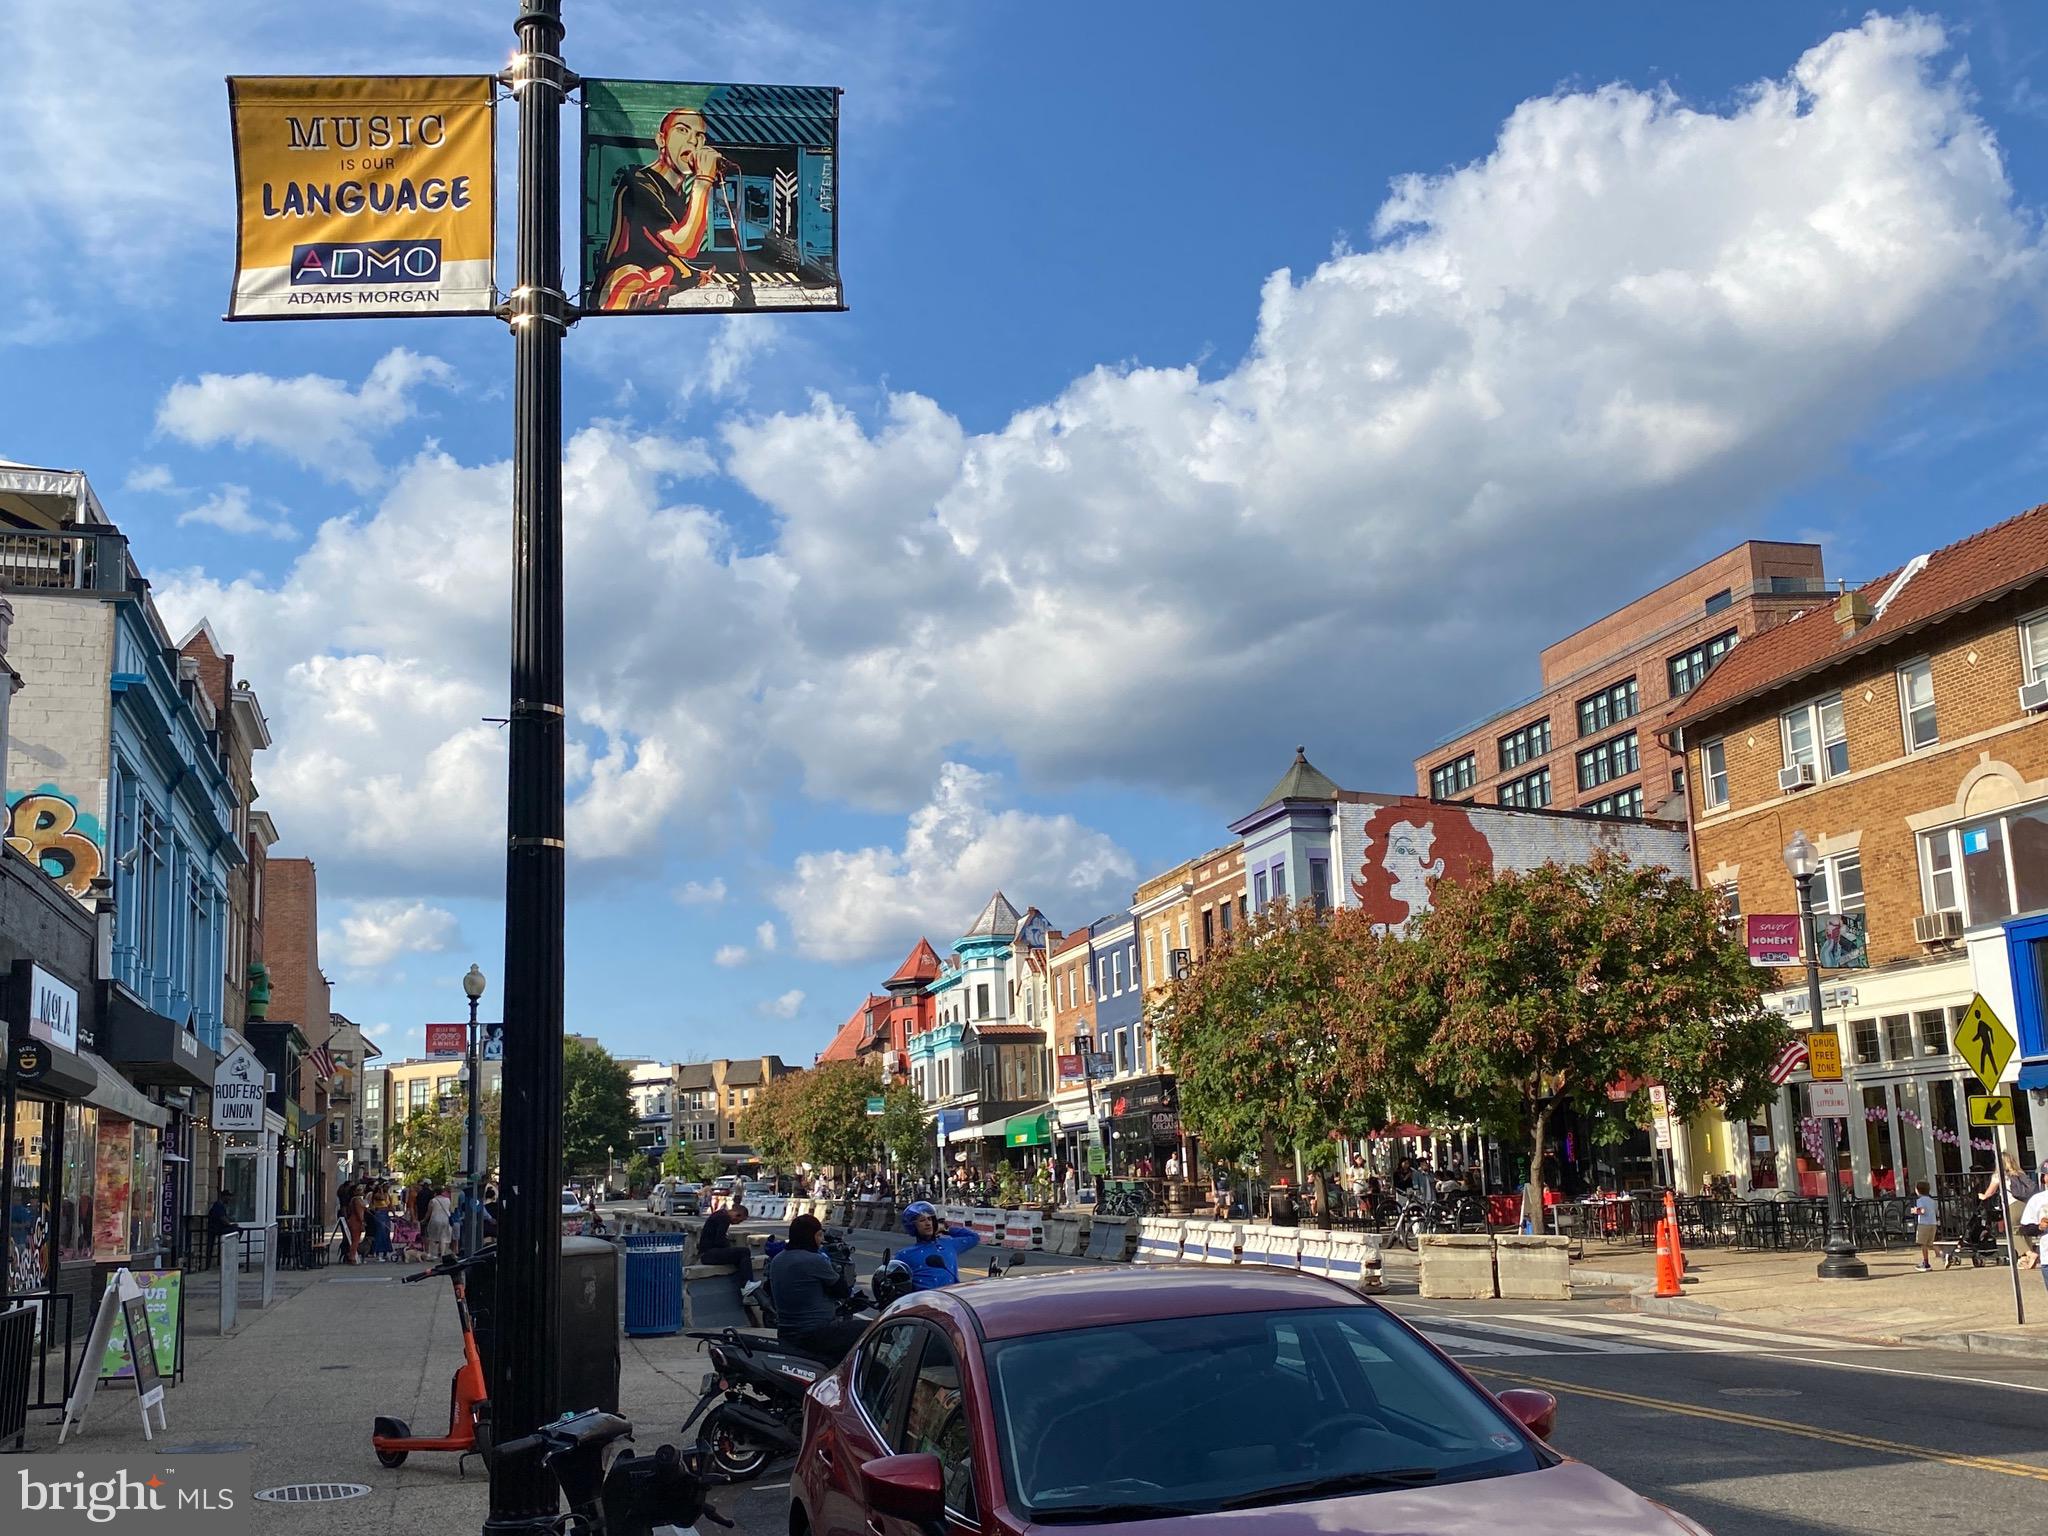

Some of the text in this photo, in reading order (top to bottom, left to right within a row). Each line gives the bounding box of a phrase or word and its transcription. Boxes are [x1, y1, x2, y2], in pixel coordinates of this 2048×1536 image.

[286, 114, 446, 151] MUSIC
[340, 157, 395, 171] IS OUR
[262, 175, 472, 220] LANGUAGE
[295, 246, 437, 280] ADMO
[287, 290, 440, 305] ADAMS MORGAN
[1752, 936, 1794, 945] MOMENT
[1813, 1039, 1835, 1047] DRUG
[1815, 1051, 1835, 1060] FREE
[1817, 1064, 1836, 1072] ZONE
[215, 1083, 264, 1100] ROOFERS
[222, 1103, 253, 1119] UNION
